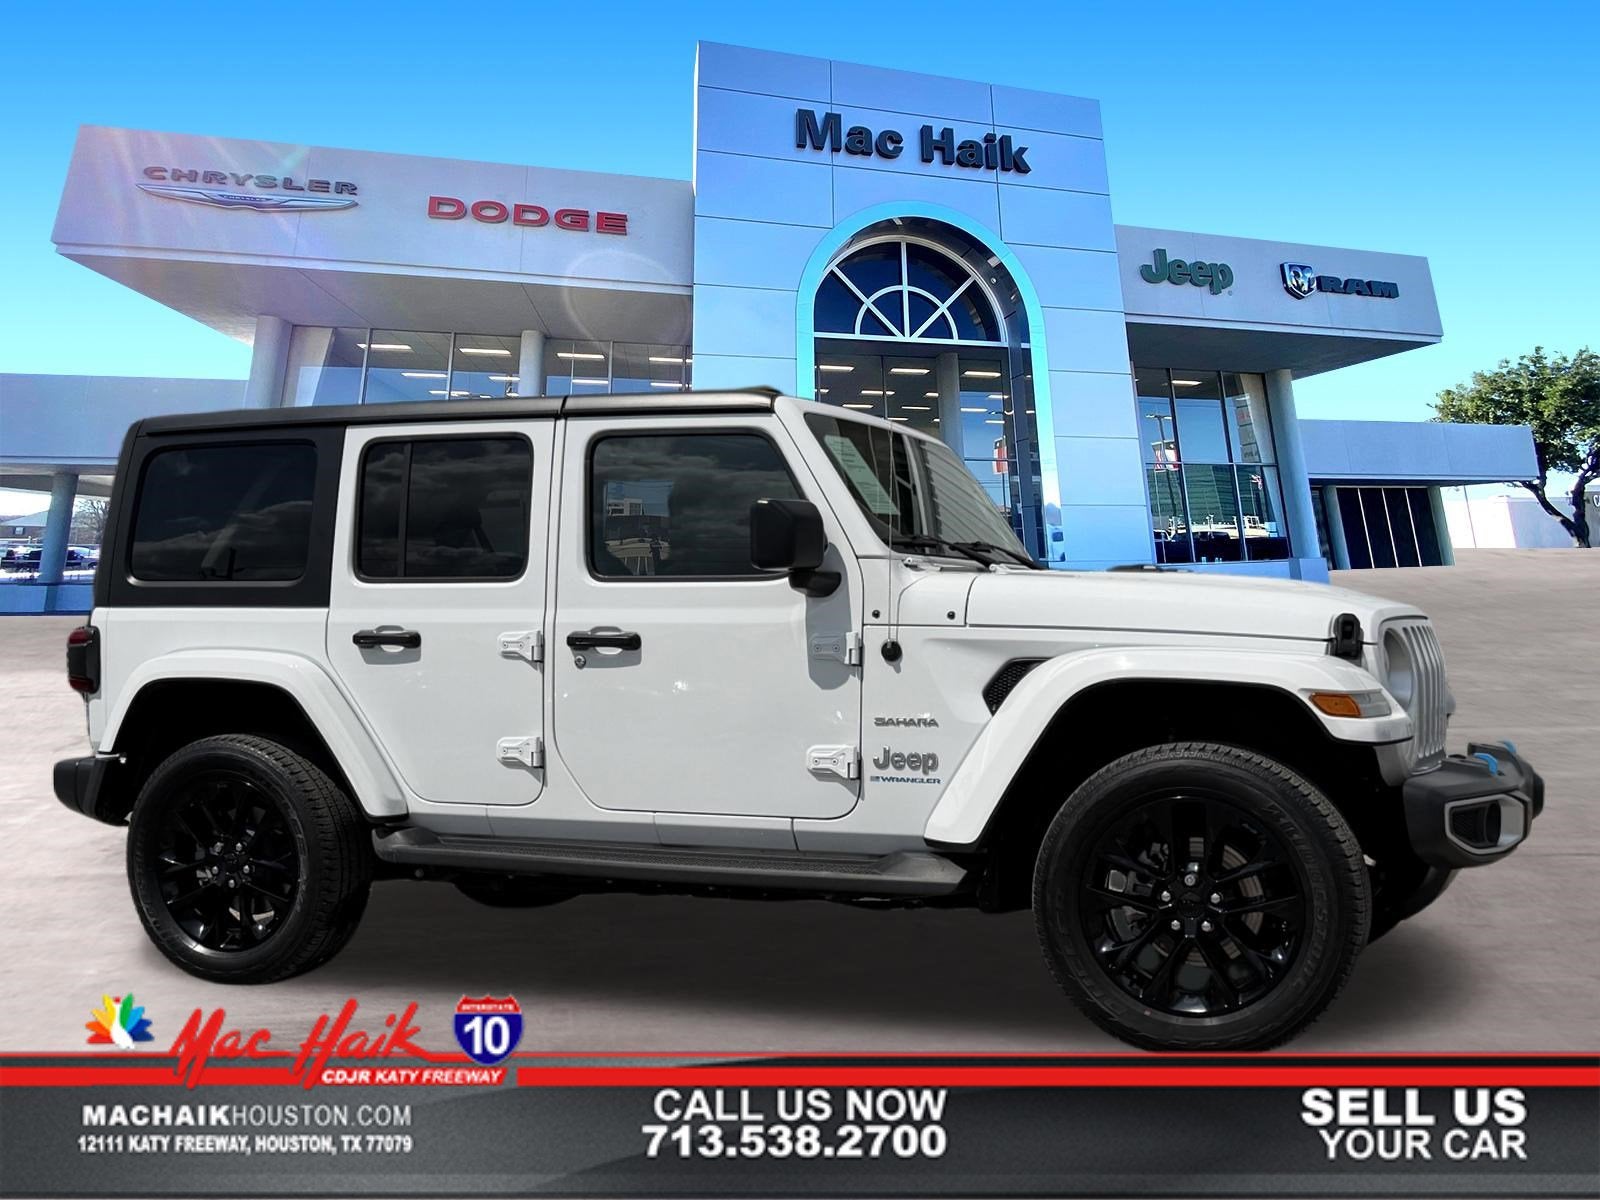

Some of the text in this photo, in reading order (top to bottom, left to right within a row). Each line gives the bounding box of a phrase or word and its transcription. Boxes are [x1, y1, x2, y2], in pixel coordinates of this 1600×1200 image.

[796, 108, 1032, 174] Mac Haik
[143, 166, 358, 196] CHRYSLER
[428, 195, 628, 236] DODGE
[1140, 248, 1234, 296] Jeep
[1316, 275, 1399, 299] RAM
[874, 717, 939, 728] SAHARA
[872, 746, 939, 776] Jeep
